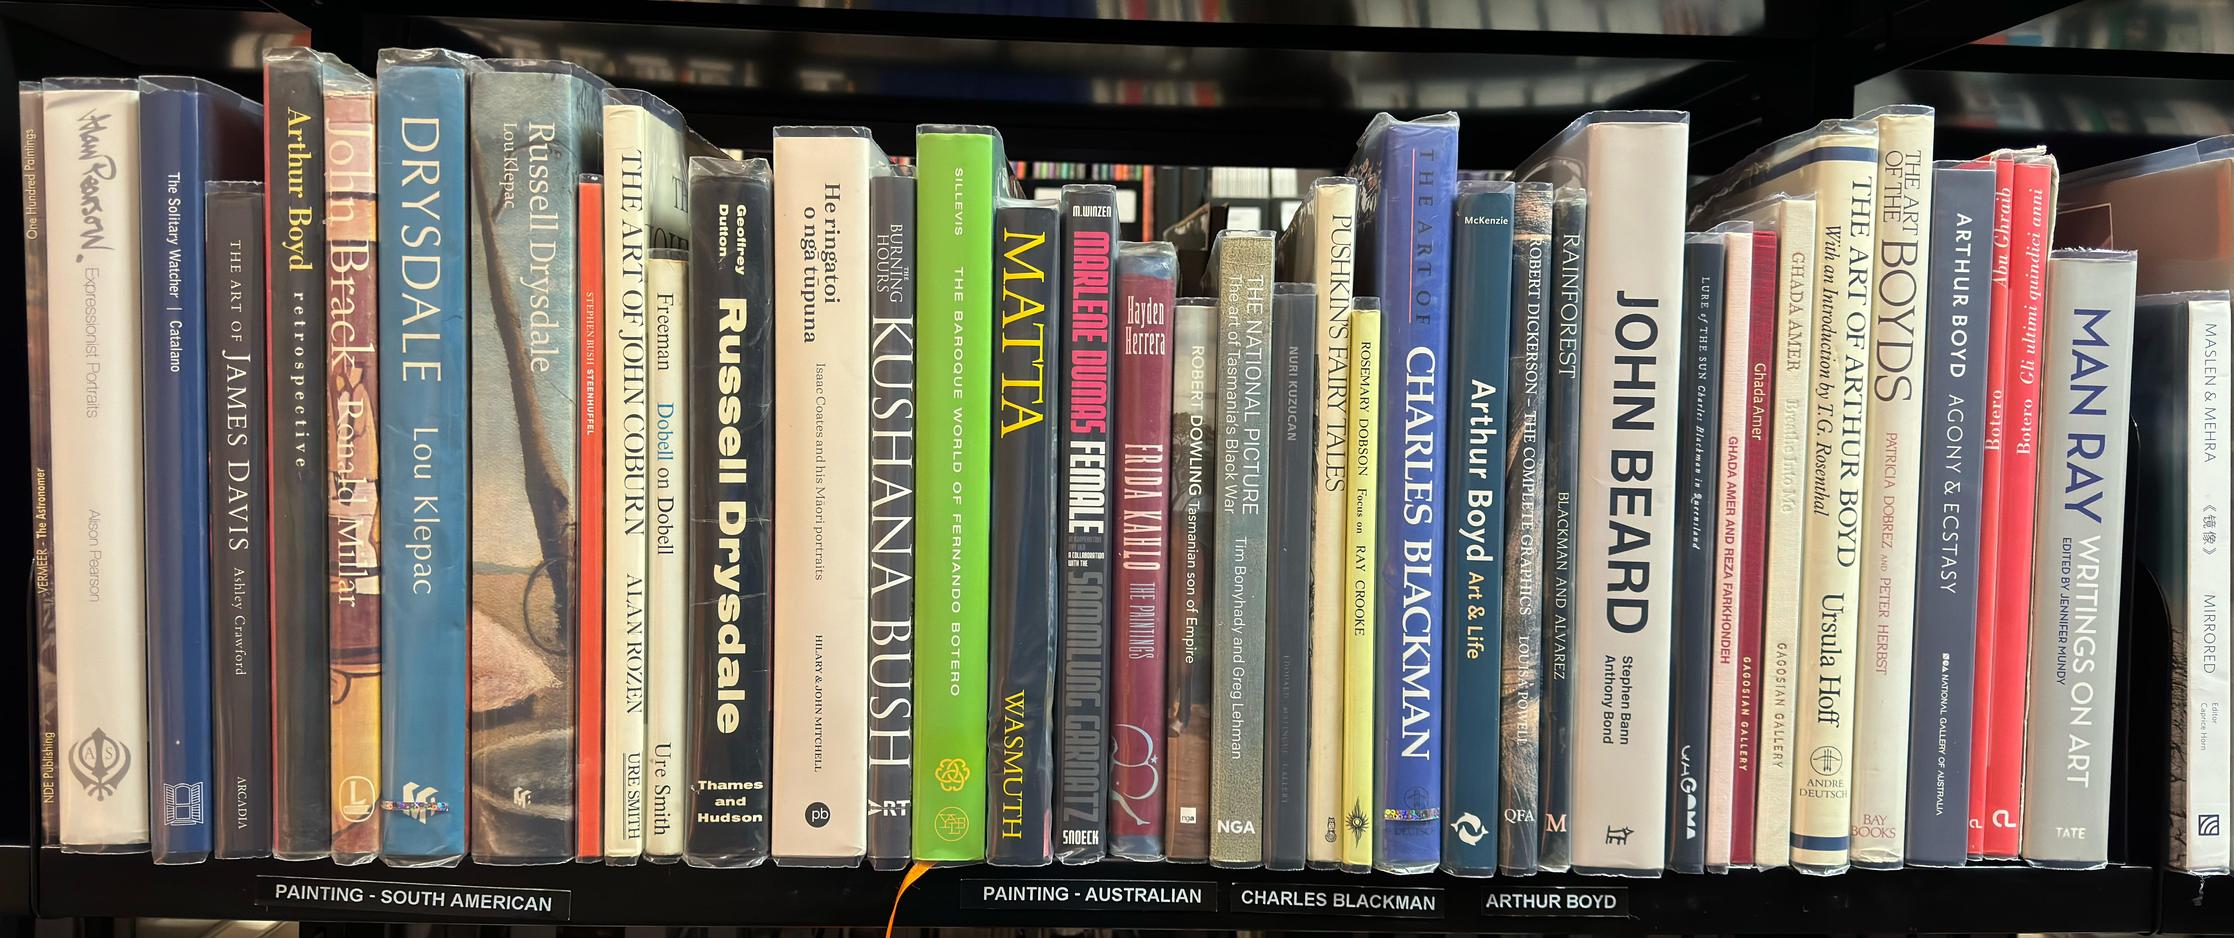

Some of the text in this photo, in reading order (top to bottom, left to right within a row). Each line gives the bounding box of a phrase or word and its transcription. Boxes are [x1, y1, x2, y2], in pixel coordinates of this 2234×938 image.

[26, 129, 38, 240] One Hundred Paintings
[499, 123, 518, 209] Lou Klepac
[719, 204, 731, 257] Dutton
[954, 168, 963, 236] SILLEVIS
[1464, 216, 1508, 226] McKenzie
[167, 172, 181, 373] The Solitary Watcher Catalano
[282, 107, 313, 467] Arthur Boyd retrospective
[327, 117, 376, 371] John Brack
[519, 121, 559, 372] Russell Drysdale
[735, 204, 748, 276] Geoffrey
[821, 183, 841, 304] He ringatoi
[1071, 232, 1110, 343] MARLENE
[1558, 234, 1581, 379] RAINFOREST
[401, 117, 442, 595] DRYSDALE Lou Klepac
[586, 291, 595, 436] STEPHEN BUSH STEENHUFFEL
[618, 150, 645, 536] THE ART OF JOHN COBURN
[1001, 227, 1046, 438] MATTA
[1125, 326, 1165, 355] Herrera
[1127, 296, 1164, 325] Hayden
[1837, 175, 1873, 568] THE ART OF ARTHUR BOYD
[1873, 239, 1918, 403] BOYDS
[1984, 187, 2012, 452] Botero Abu Ghraib
[2016, 188, 2043, 455] Botero Gli ultimi quindici anni
[222, 240, 251, 551] THE ART OF JAMES DAVIS
[657, 293, 674, 556] Freeman Dobell on Dobell
[1070, 350, 1107, 433] DUMAS
[1188, 345, 1204, 495] ROBERT DOWLING
[1242, 275, 1264, 515] THE NATIONAL PICTURE
[1327, 346, 1348, 415] FAIRY
[1751, 363, 1767, 441] Ghada Amer
[1939, 213, 1974, 595] ARTHUR BOYD AGONY & ECSTASY
[2204, 323, 2218, 463] MASLEN & MEHRA
[714, 298, 747, 735] Russell Drysdale
[950, 266, 963, 696] THE BAROQUE WORLD OF FERNANDO BOTERO
[1067, 441, 1106, 534] FEMALE
[1123, 444, 1163, 571] FRIDA KAHLO
[1325, 417, 1346, 492] TALES
[1354, 342, 1371, 637] ROSEMARY DOBSON Focus on RAY CROOKE
[1459, 380, 1496, 660] Arthur Boyd Art & Life
[1605, 290, 1658, 634] JOHN BEARD
[868, 314, 914, 769] KUSHANA BUSH
[1401, 346, 1436, 760] CHARLES BLACKMAN
[1720, 436, 1739, 664] GHADA AMER AND REZA FARKHONDEH
[2064, 308, 2111, 789] MAN RAY WRITINGS ON ART
[1817, 592, 1843, 728] Ursula Hoff
[2056, 537, 2072, 686] EDITED BY JENNIFER MUNDY
[2203, 594, 2216, 675] MIRRORED
[1002, 690, 1026, 839] WASMUTH
[1602, 655, 1615, 744] Anthony Bond
[1620, 655, 1633, 745] Stephen Bann
[1739, 656, 1751, 771] GAGOSIAN GALLERY
[697, 780, 764, 790] Thames
[697, 812, 764, 824] Hudson
[715, 796, 747, 807] and
[1063, 830, 1099, 845] SNOECK
[1217, 819, 1255, 835] NGA
[2055, 827, 2086, 840] TATE
[275, 884, 553, 912] PAINTING SOUTH AMERICAN
[983, 885, 1202, 904] PAINTING AUSTRALIAN
[1241, 889, 1436, 911] CHARLES BLACKMAN
[1485, 892, 1617, 909] ARTHUR BOYD
